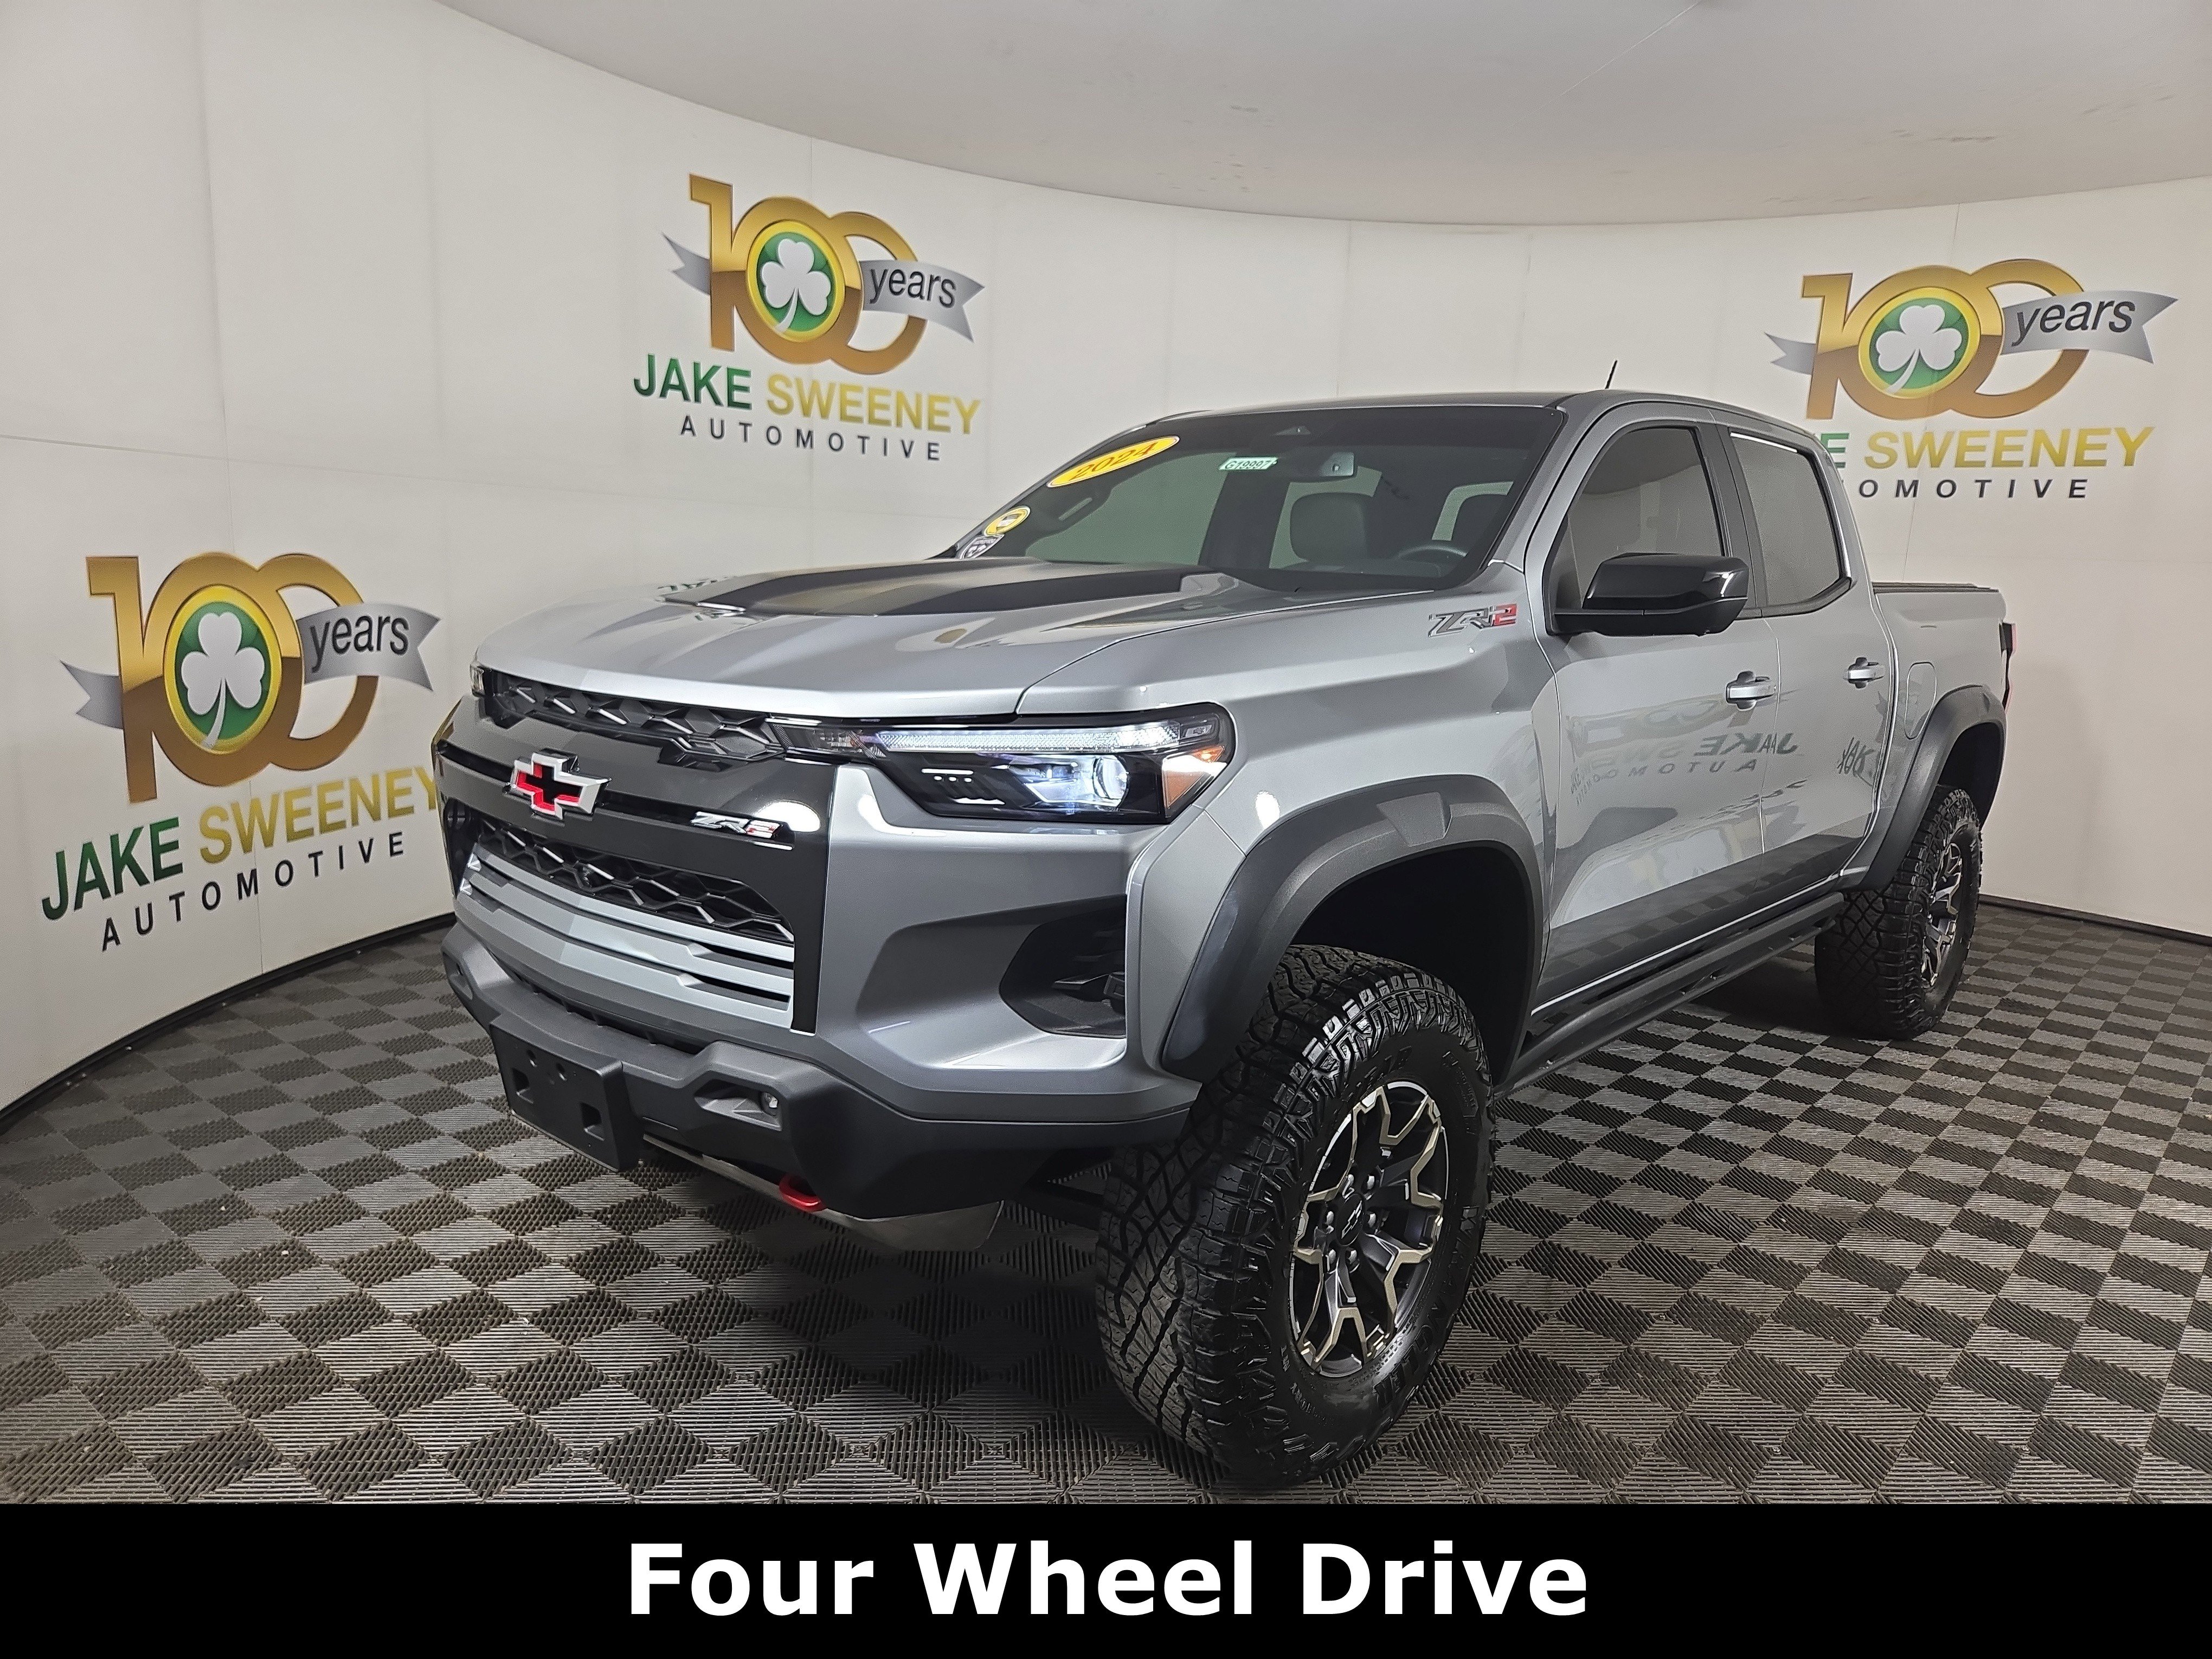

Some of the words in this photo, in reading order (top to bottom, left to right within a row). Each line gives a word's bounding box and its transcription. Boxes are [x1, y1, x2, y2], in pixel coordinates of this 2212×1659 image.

[689, 173, 928, 375] 100
[870, 265, 956, 308] years
[1802, 259, 2089, 420] 100
[2011, 298, 2136, 347] years
[634, 353, 753, 411] JAKE
[767, 373, 981, 435] SWEENEY
[681, 415, 940, 461] AUTOMOTIVE
[1069, 442, 1158, 481] 2024
[1865, 426, 2155, 469] SWEENEY
[1859, 478, 2088, 498] OMOTIVE
[1427, 603, 1517, 638] ZR2
[86, 552, 378, 803] 100
[310, 615, 409, 672] years
[42, 817, 183, 921] JAKE
[199, 766, 436, 864] SWEENEY
[690, 811, 781, 839] ZR2
[102, 832, 404, 951] AUTOMOTIVE
